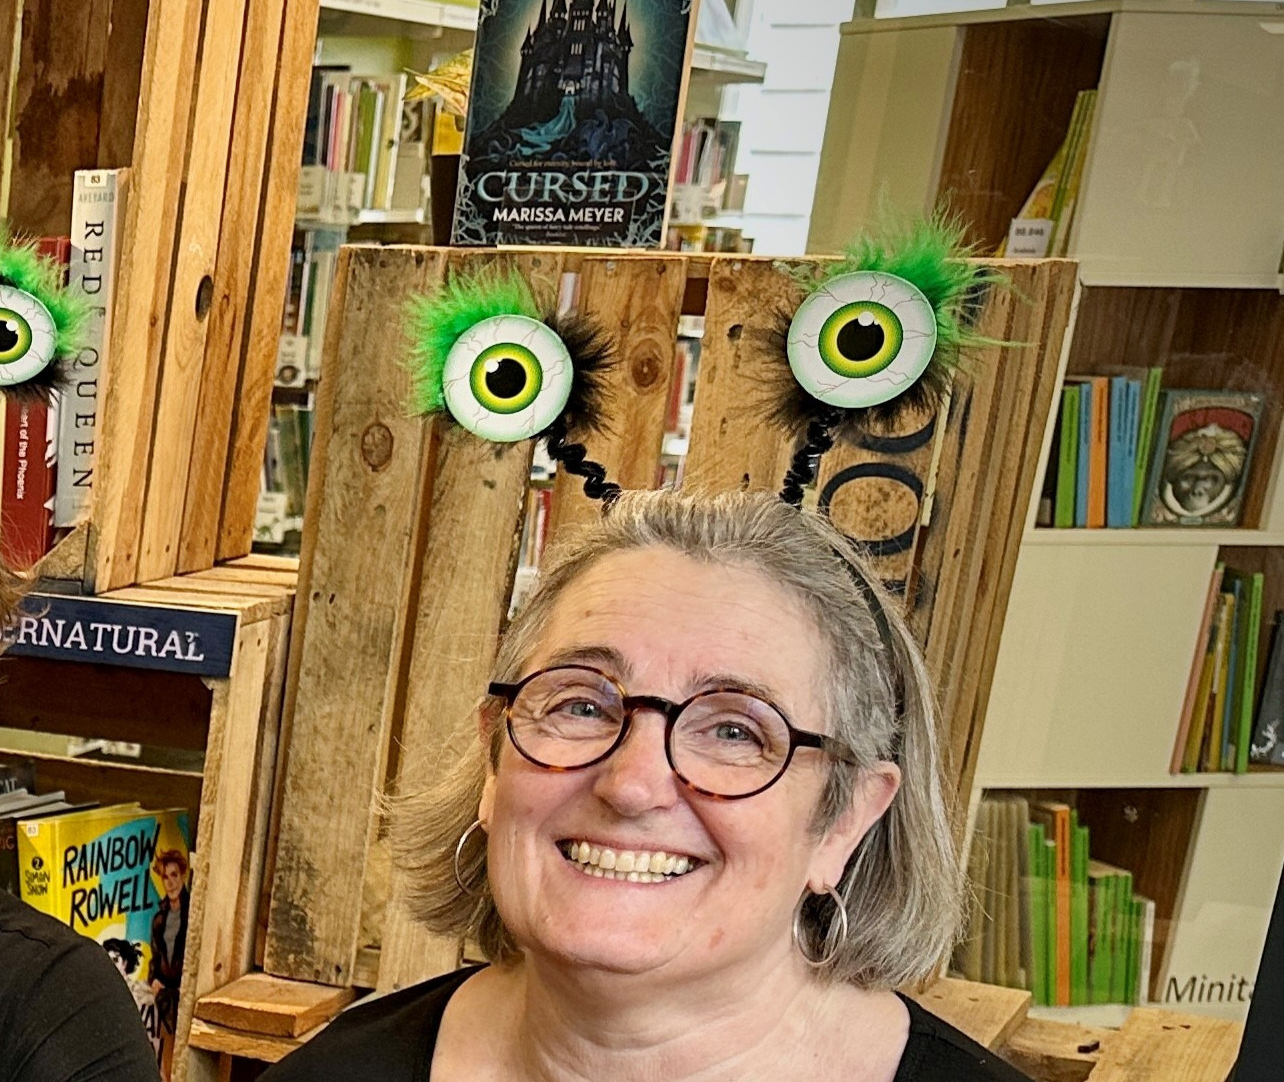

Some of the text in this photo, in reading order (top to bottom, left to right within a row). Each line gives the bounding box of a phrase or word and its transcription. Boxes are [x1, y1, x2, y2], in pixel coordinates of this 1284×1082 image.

[91, 175, 100, 184] 83
[477, 169, 649, 205] CURSED
[493, 207, 624, 223] MARISSA MEYER
[72, 221, 104, 490] RED QUEEN
[63, 823, 161, 888] RAINBOW
[70, 869, 153, 928] ROWELL
